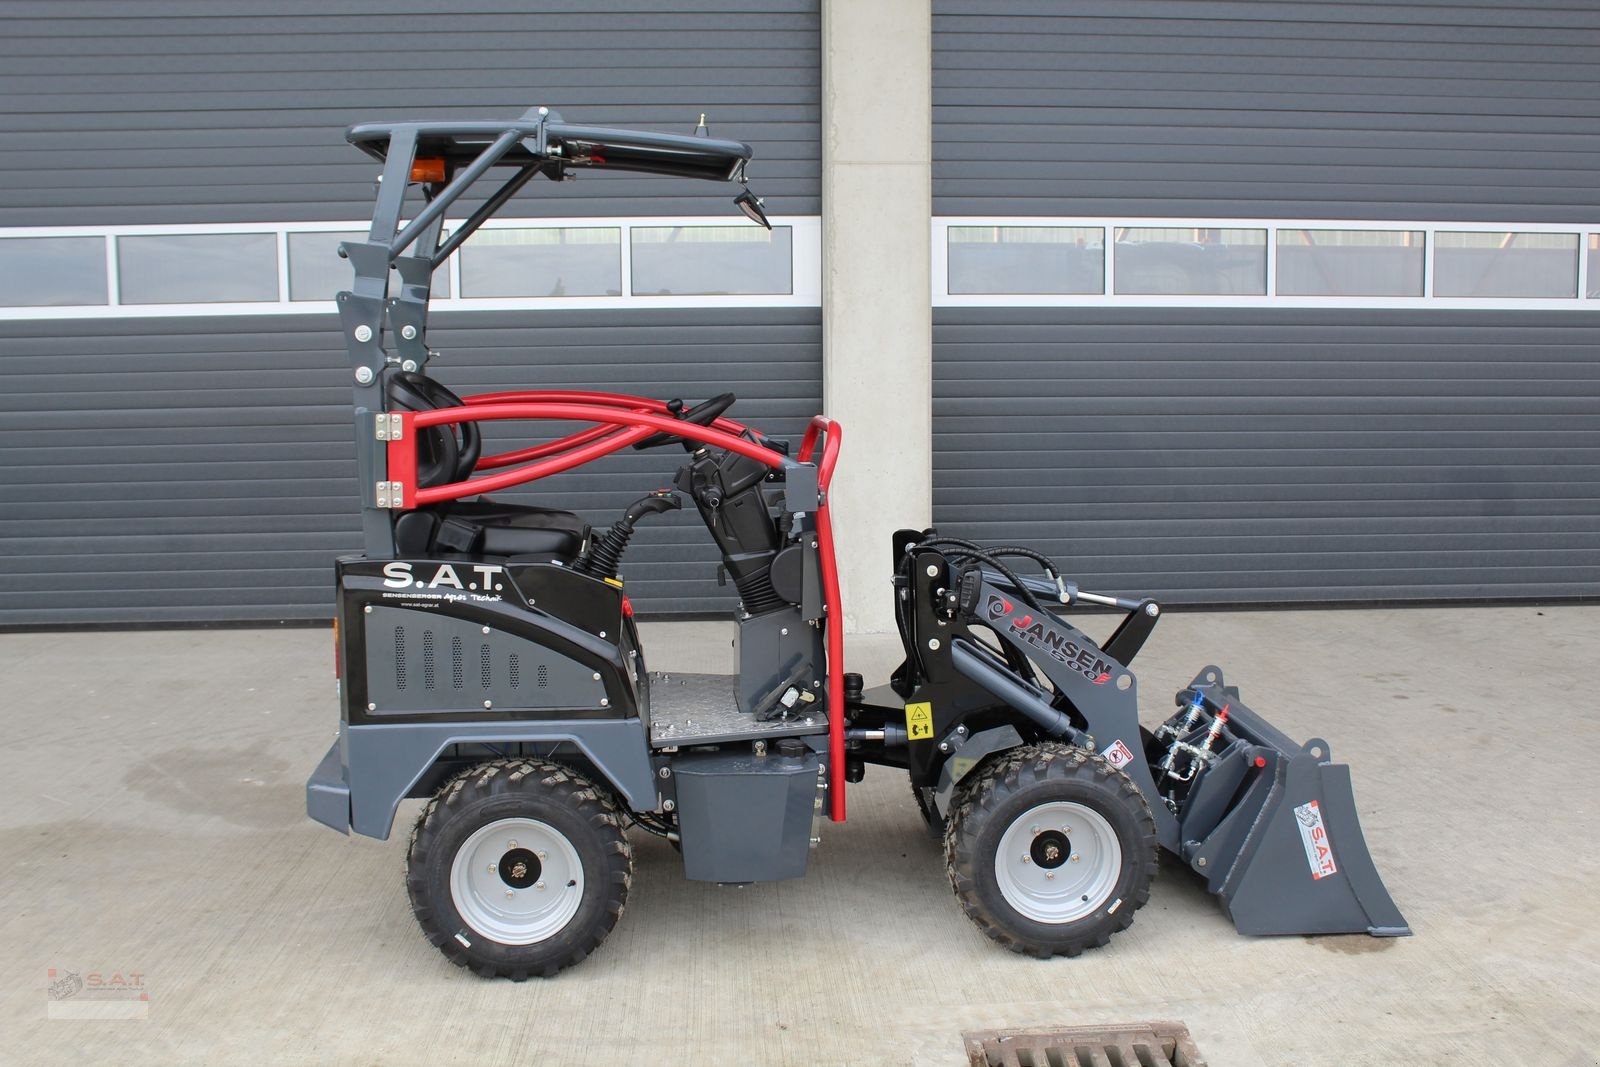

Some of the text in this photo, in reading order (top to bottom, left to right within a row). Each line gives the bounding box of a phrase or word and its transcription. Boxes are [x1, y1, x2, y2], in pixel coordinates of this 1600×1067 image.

[383, 562, 503, 591] S.A.T.
[470, 593, 503, 602] Technik
[1013, 615, 1113, 675] JANSEN
[1311, 826, 1334, 873] S.A.T.
